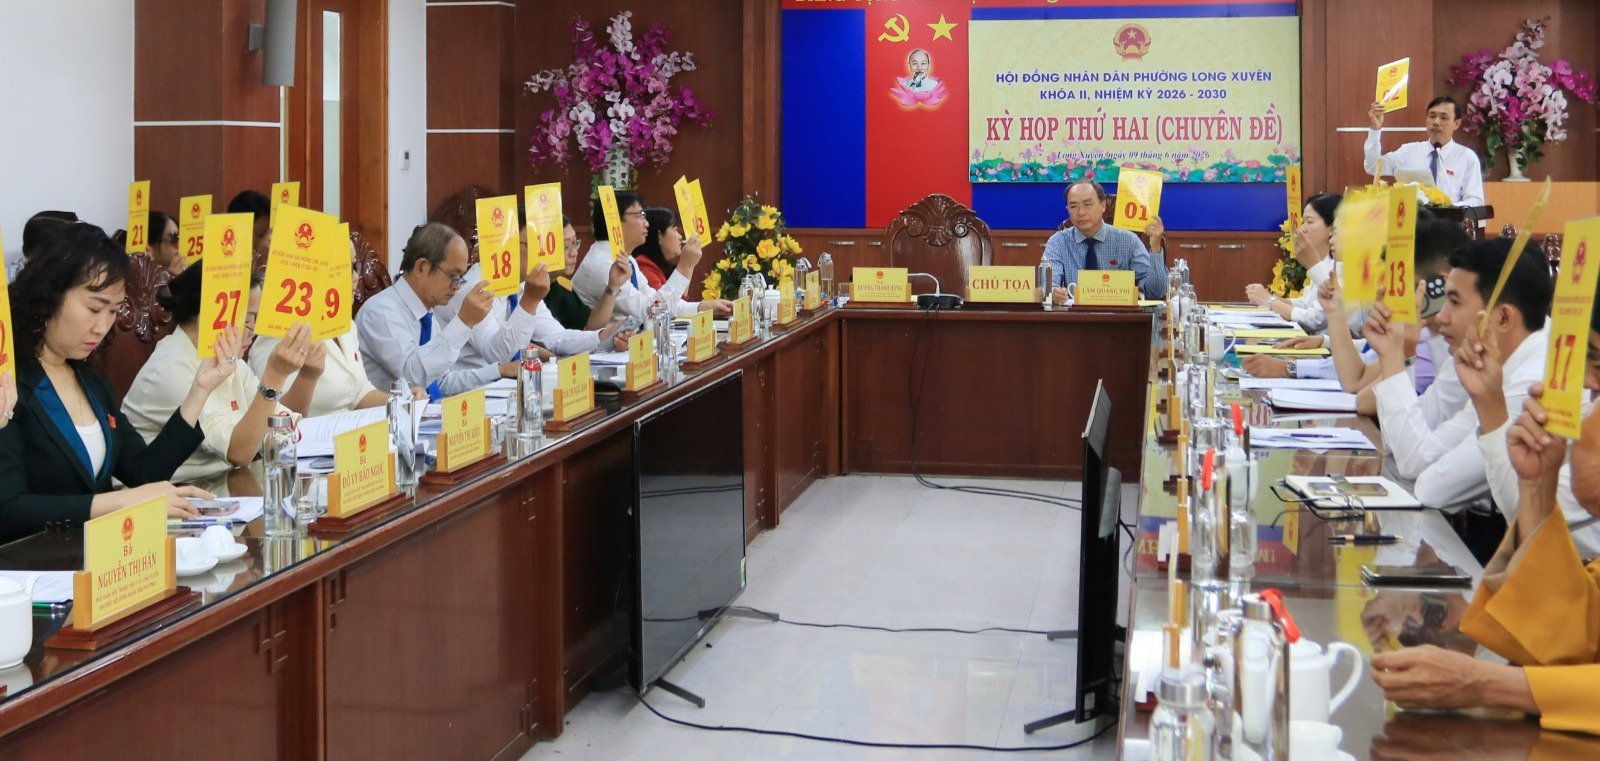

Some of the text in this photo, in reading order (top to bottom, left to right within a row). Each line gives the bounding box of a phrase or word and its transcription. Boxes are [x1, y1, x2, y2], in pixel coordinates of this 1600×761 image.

[996, 68, 1272, 85] HỘI ĐỒNG NHÂN DÂN PHƯỜNG LONG XUYÊN
[1040, 88, 1076, 100] KHÓA
[1079, 90, 1090, 101] II,
[1094, 88, 1133, 102] NHIỆM
[1137, 87, 1152, 99] KỲ
[1157, 89, 1187, 99] 2026
[1197, 89, 1227, 99] 2030
[986, 102, 1283, 148] KỲ HỌP THỨ HAI (CHUYÊN ĐỀ)
[1057, 151, 1078, 161] Long
[1128, 151, 1139, 160] 09
[1140, 150, 1162, 161] tháng
[1164, 151, 1170, 160] 6
[1171, 151, 1189, 160] năm
[1124, 202, 1148, 221] 01
[131, 224, 144, 246] 21
[537, 231, 556, 257] 10
[187, 236, 203, 257] 25
[491, 251, 512, 280] 18
[971, 275, 1031, 294] CHỦ TỌA
[1388, 260, 1406, 297] 13
[275, 278, 313, 317] 23
[321, 288, 340, 320] 9
[212, 289, 241, 330] 27
[1549, 334, 1576, 391] 17
[359, 456, 366, 465] Bà
[370, 463, 385, 478] NGỌC
[123, 544, 133, 557] Bà
[98, 560, 127, 590] NGUYỄN
[129, 558, 141, 577] THỊ
